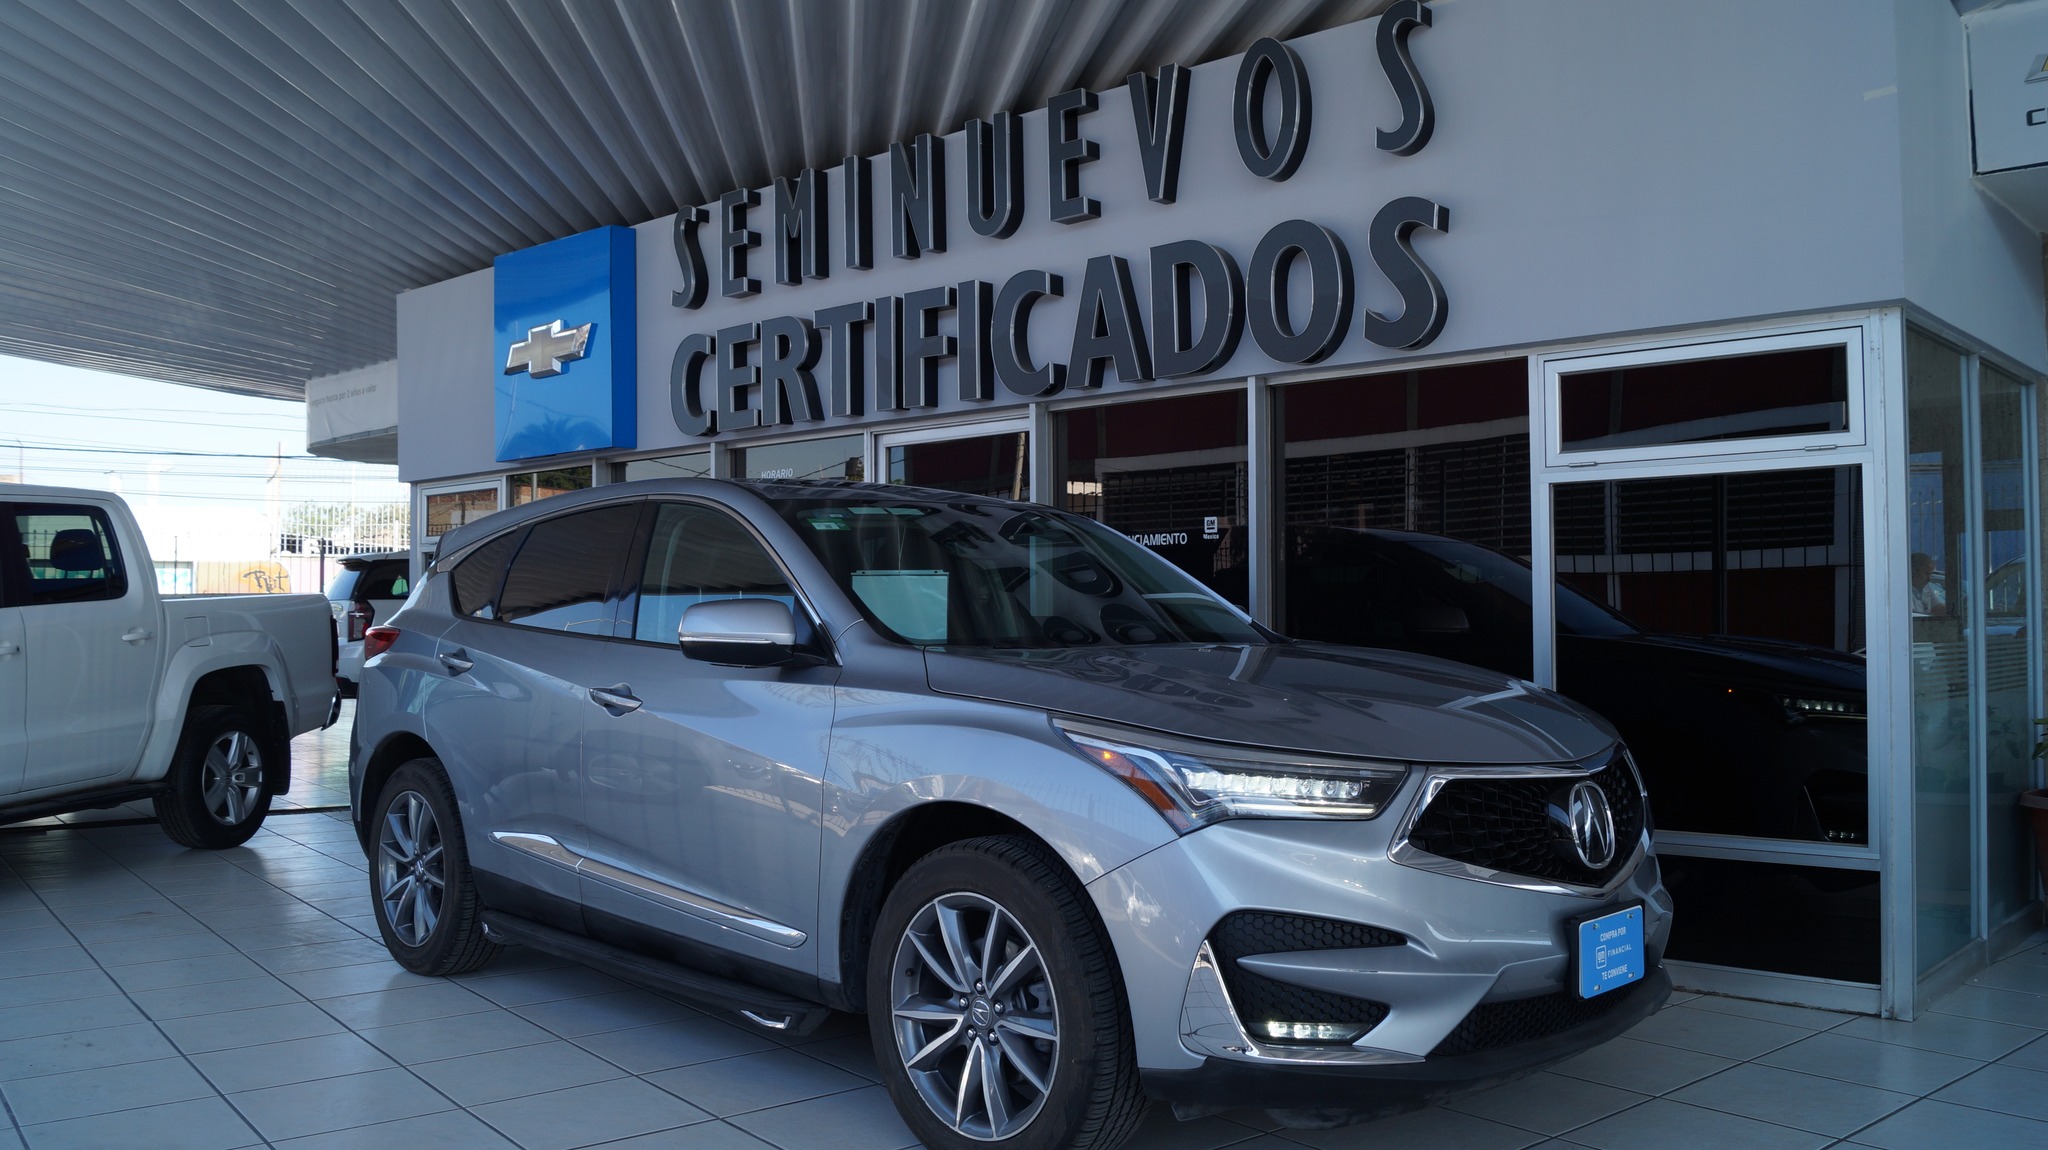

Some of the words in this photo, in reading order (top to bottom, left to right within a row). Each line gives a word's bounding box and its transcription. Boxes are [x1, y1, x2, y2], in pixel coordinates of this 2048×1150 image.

[671, 0, 1435, 310] SEMINUEVOS
[669, 196, 1450, 437] CERTIFICADOS
[761, 468, 794, 479] HORARIO
[1600, 929, 1618, 942] COMPRA
[1617, 926, 1627, 937] POR
[1608, 944, 1632, 957] FINANCIAL
[1602, 970, 1608, 980] TE
[1608, 964, 1628, 979] CONVIENE
